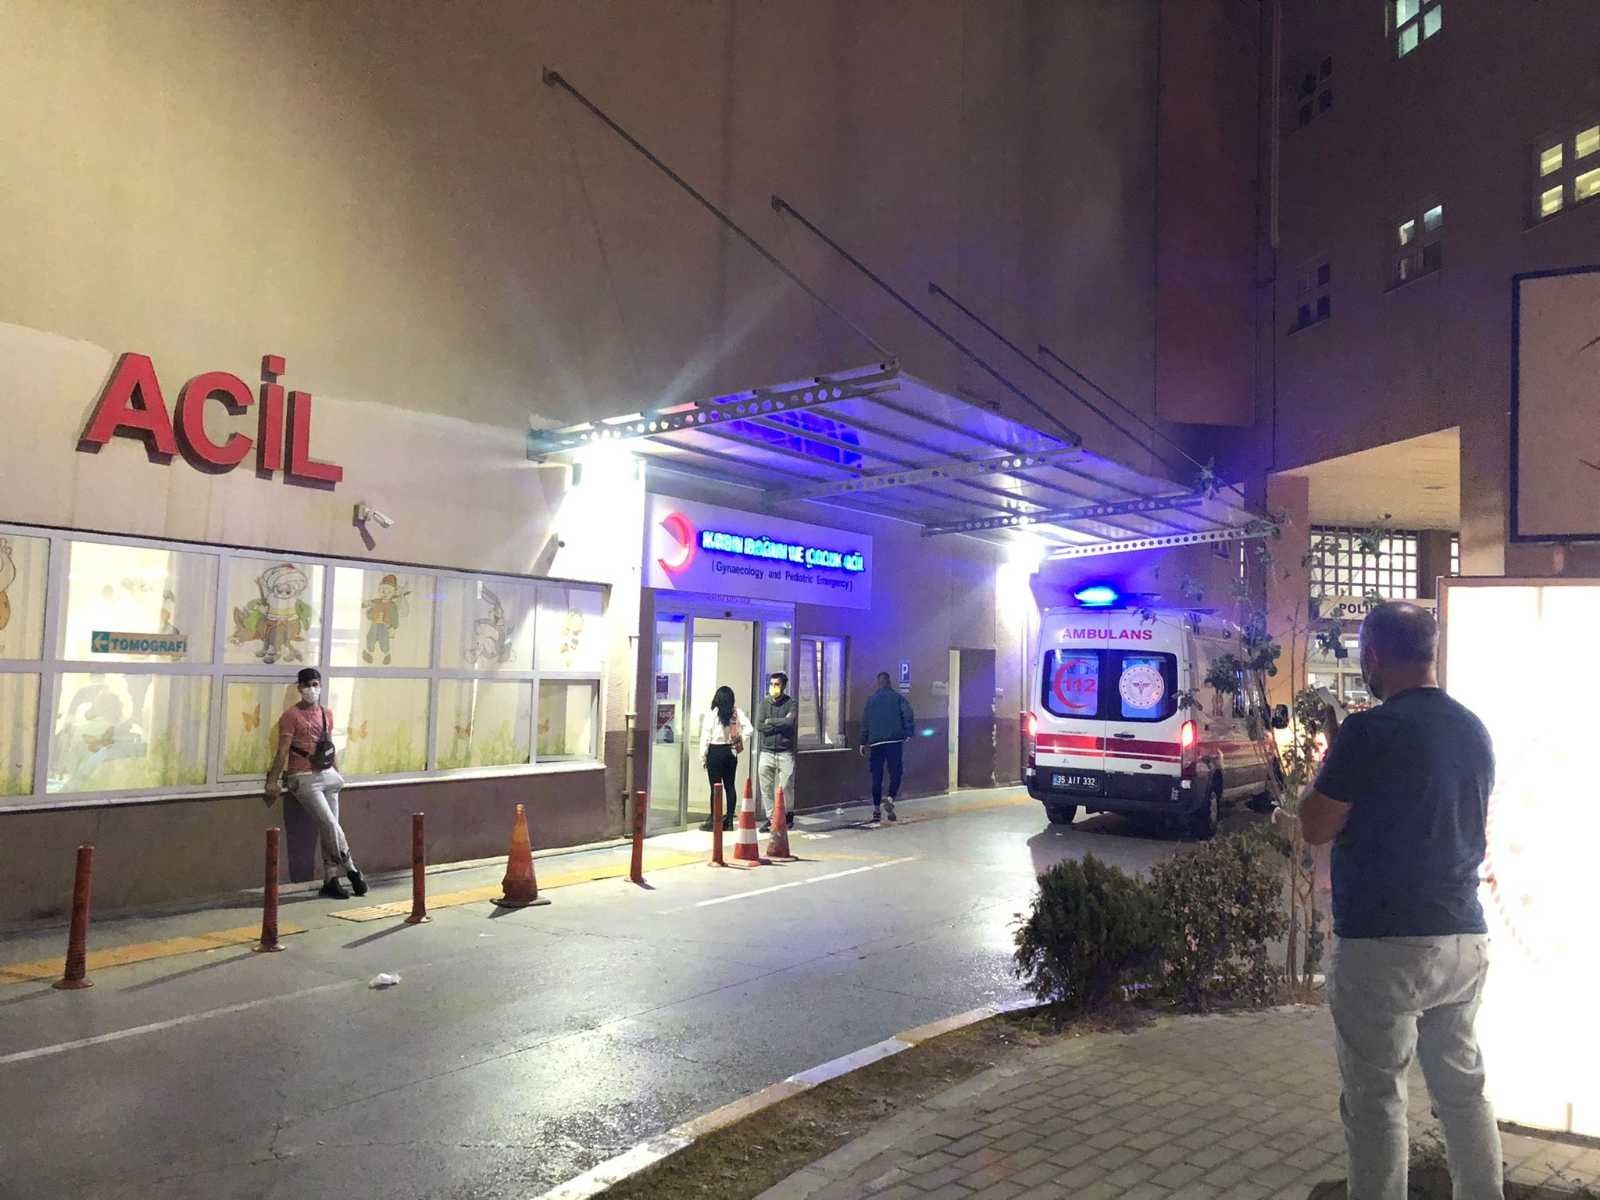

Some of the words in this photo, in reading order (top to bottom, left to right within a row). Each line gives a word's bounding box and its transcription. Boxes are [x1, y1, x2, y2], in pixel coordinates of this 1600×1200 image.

[76, 352, 343, 491] ACİL
[768, 570, 781, 580] and
[1062, 628, 1153, 640] AMBULANS
[901, 663, 909, 681] P
[1064, 677, 1097, 693] 112
[1056, 775, 1066, 785] 35
